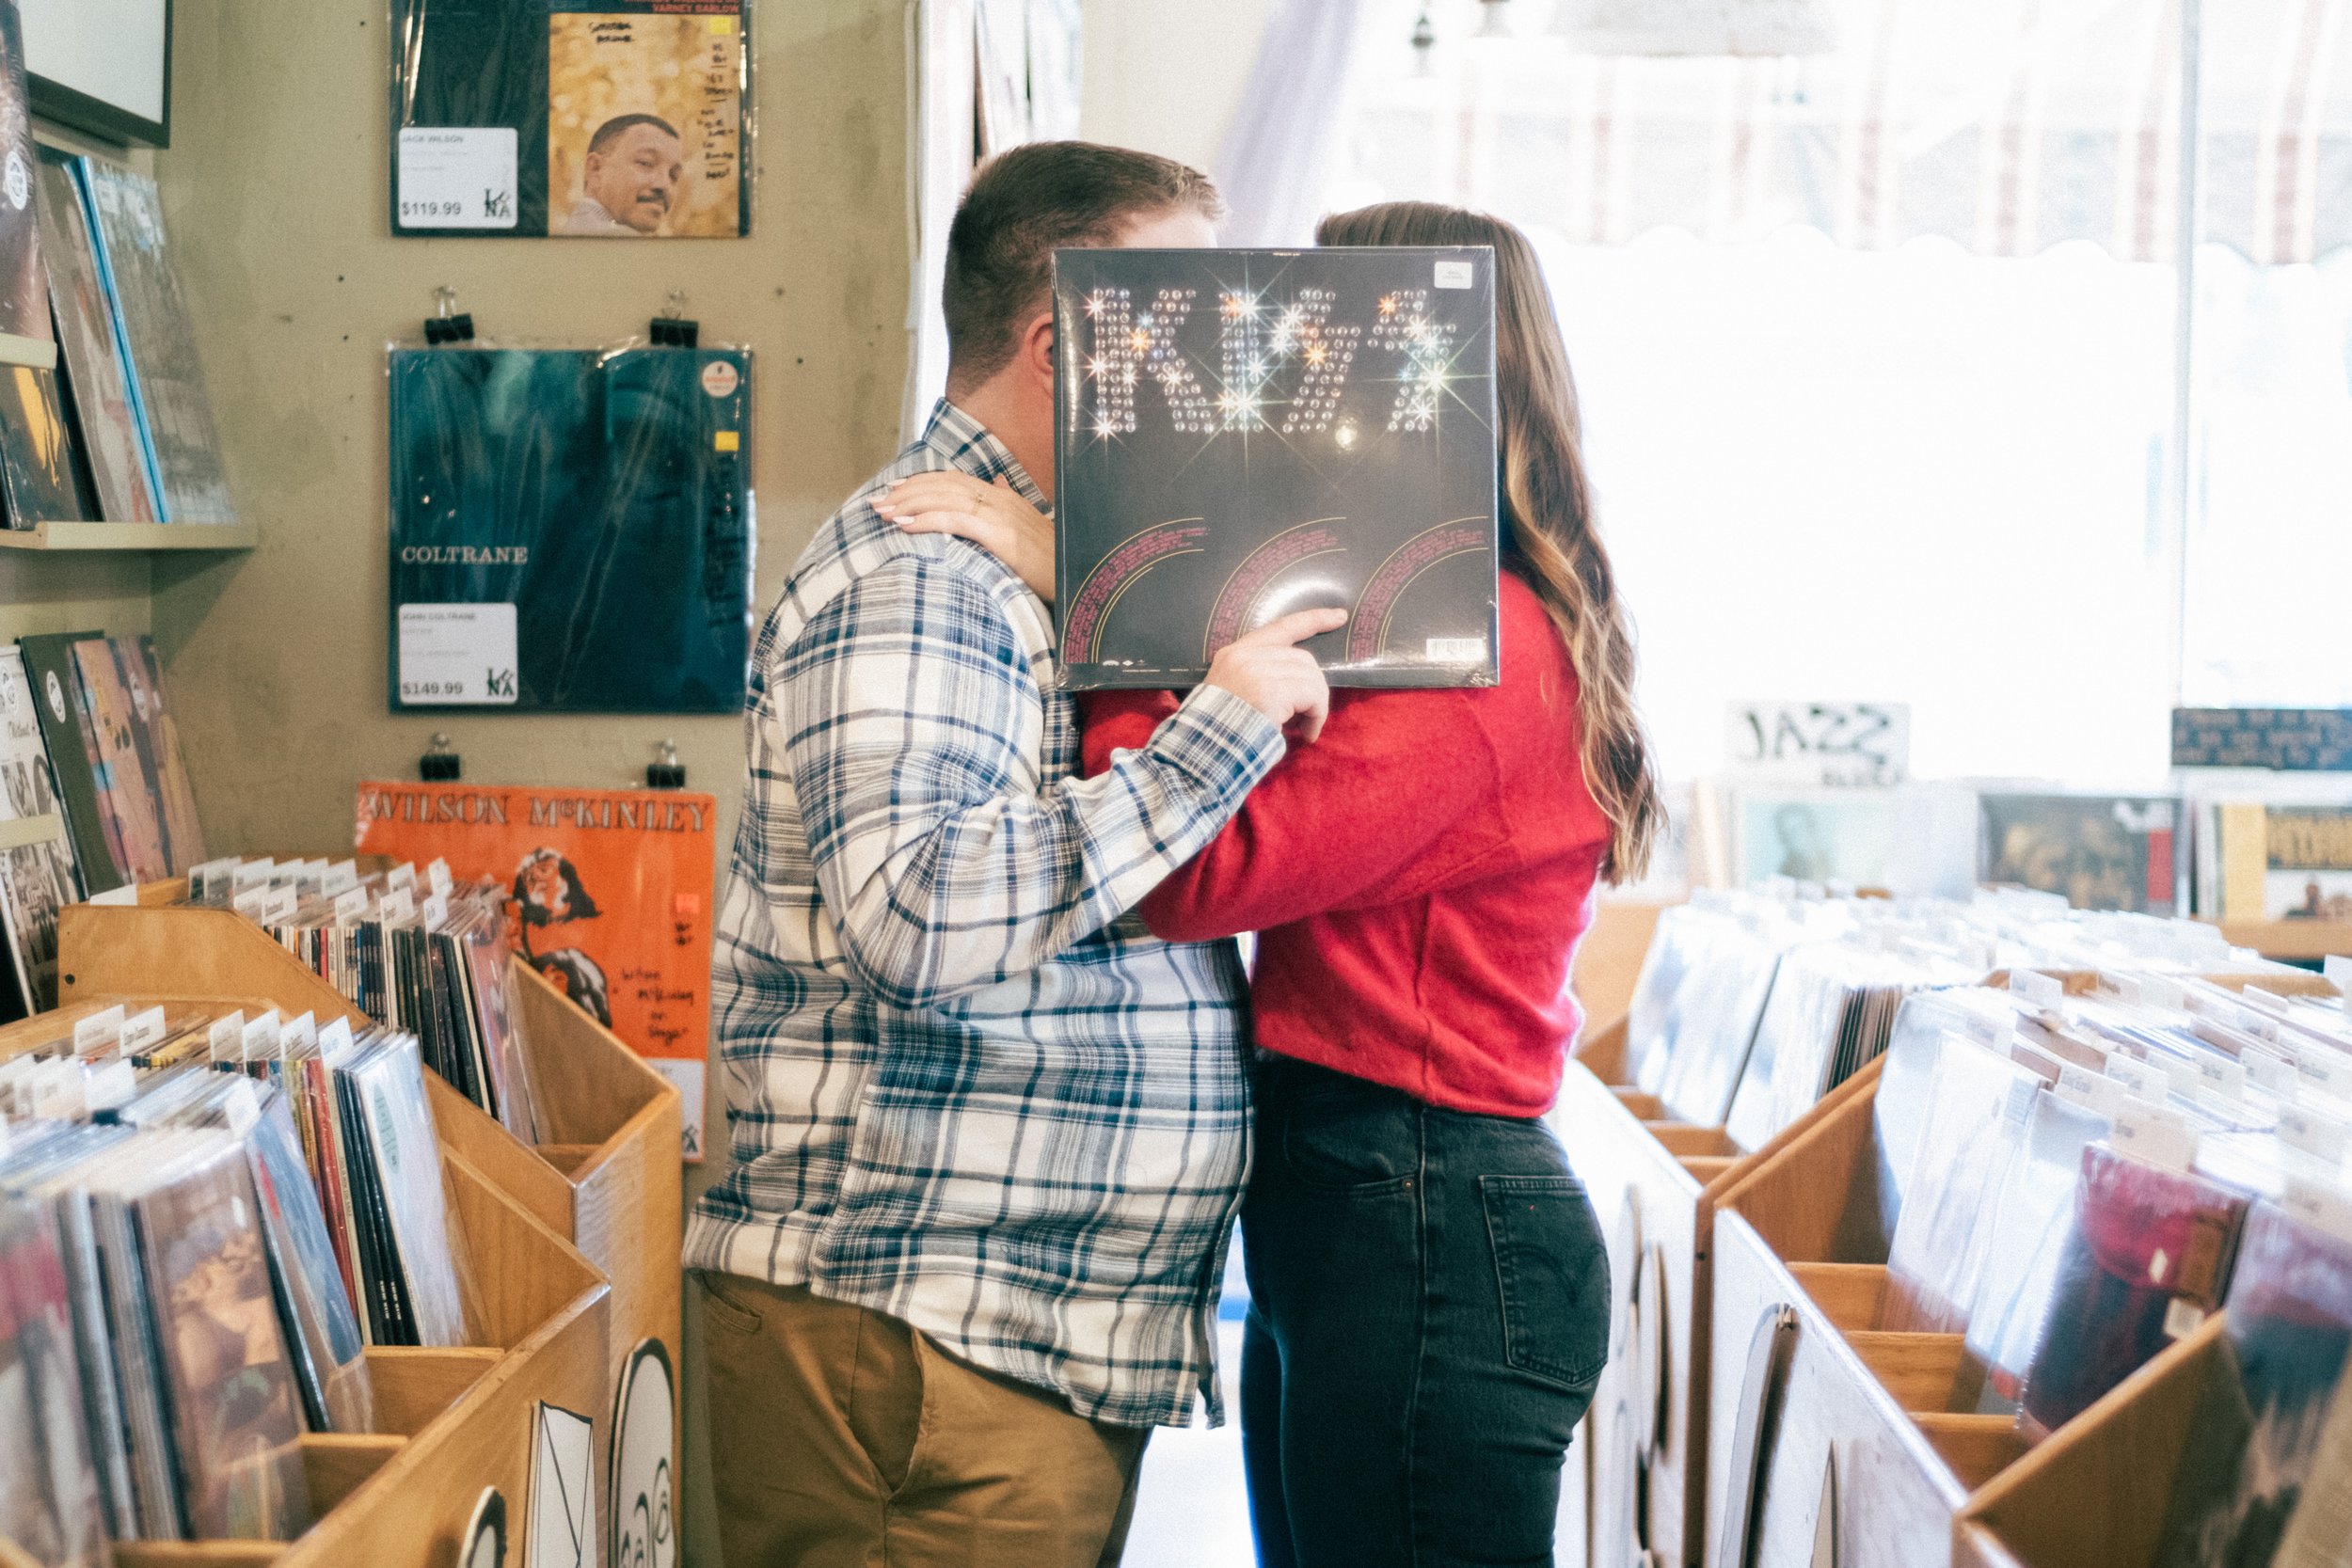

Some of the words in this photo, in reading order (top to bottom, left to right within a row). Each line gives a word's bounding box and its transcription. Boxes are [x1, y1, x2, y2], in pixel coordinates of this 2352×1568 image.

[402, 201, 461, 215] $119.99
[402, 546, 528, 563] COLTRANE
[402, 682, 463, 695] $149.99
[365, 791, 511, 826] WILSON
